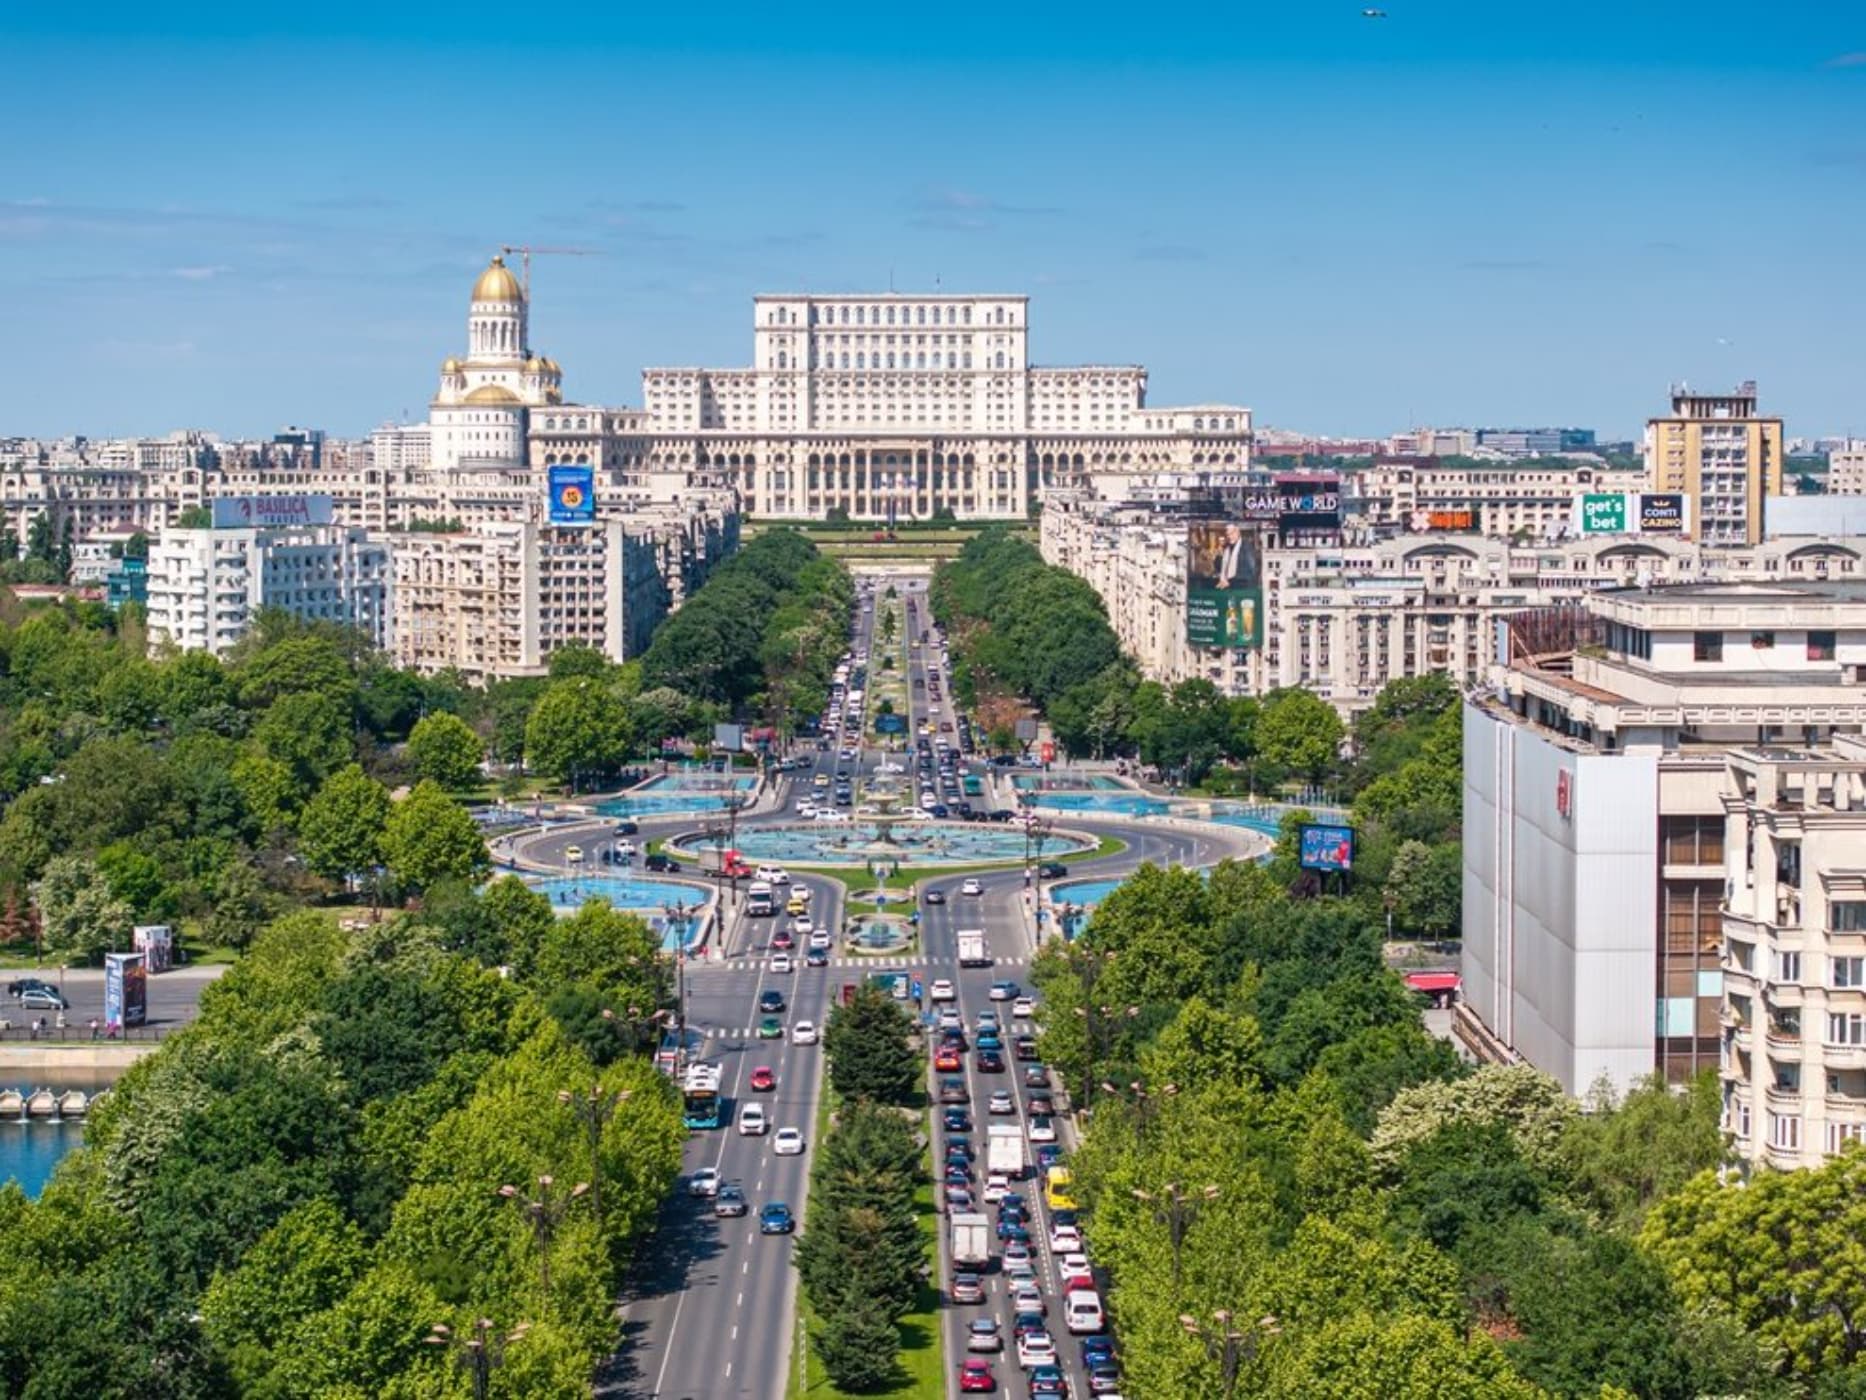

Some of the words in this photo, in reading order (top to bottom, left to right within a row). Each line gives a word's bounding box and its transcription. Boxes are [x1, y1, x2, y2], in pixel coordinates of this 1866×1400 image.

[256, 497, 310, 521] BASILICA
[1585, 499, 1623, 516] get's
[1644, 508, 1677, 518] CONTI
[1591, 516, 1617, 529] bet
[1641, 518, 1681, 528] CAZINO
